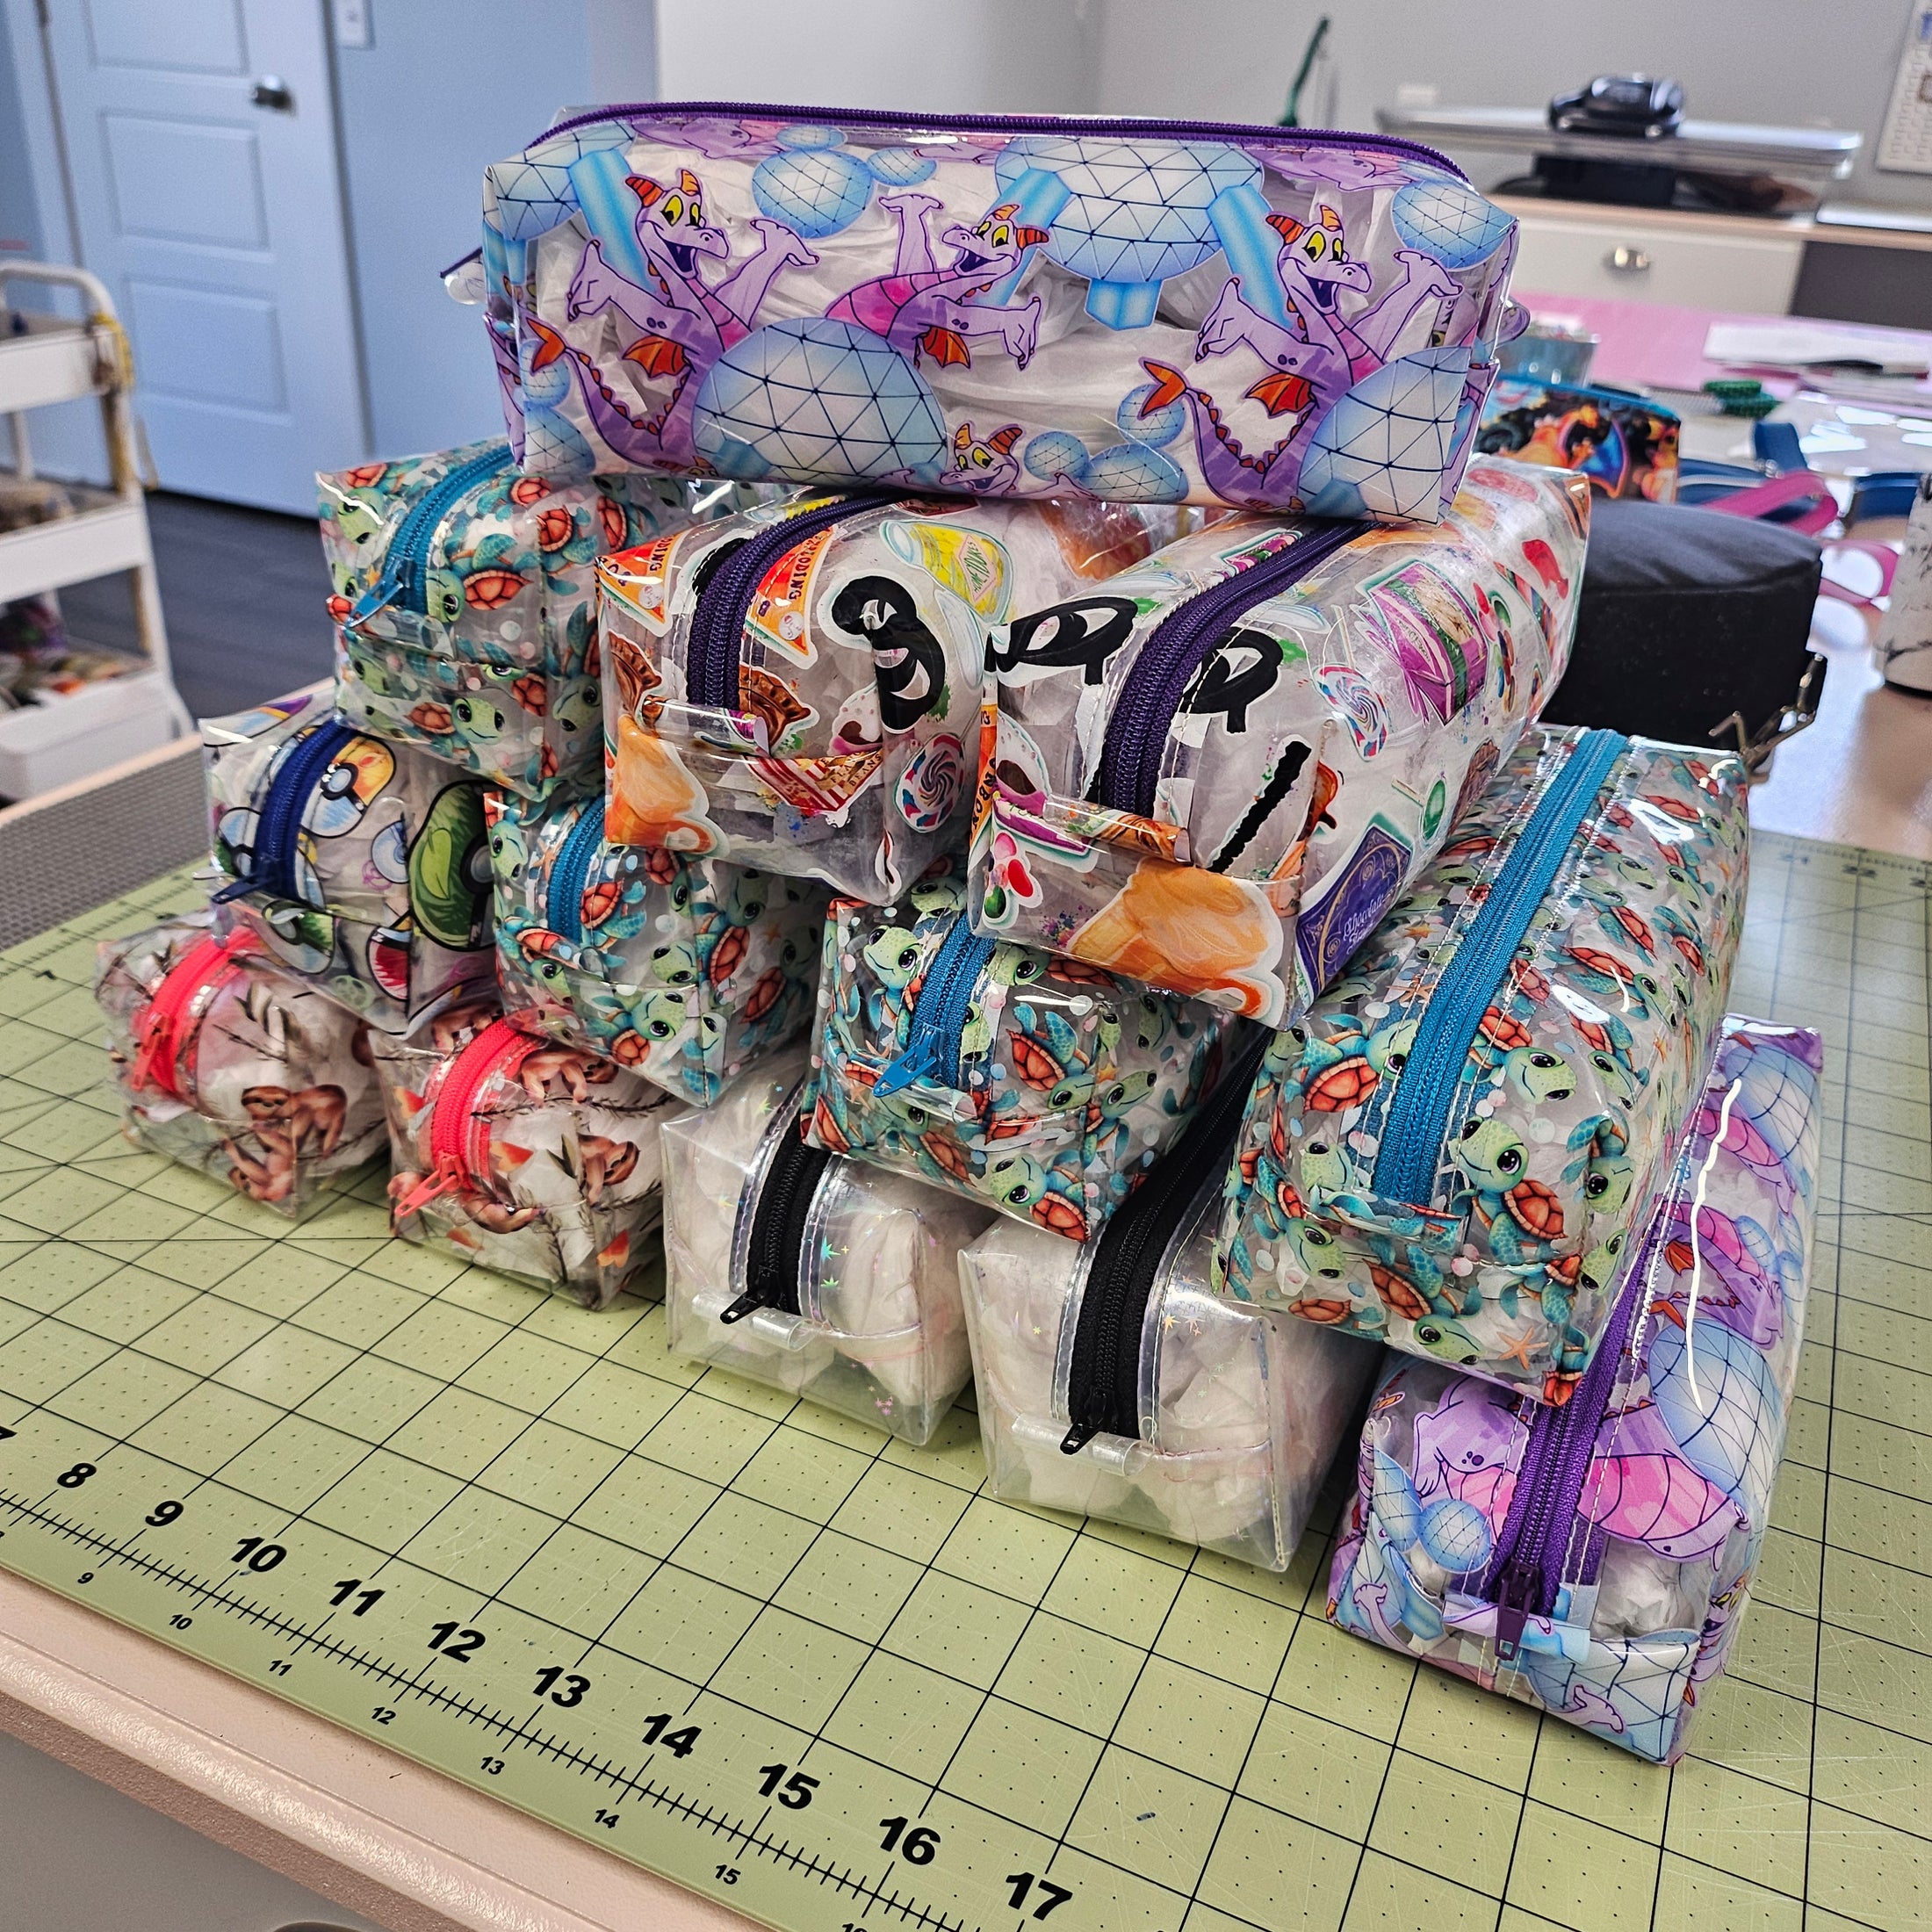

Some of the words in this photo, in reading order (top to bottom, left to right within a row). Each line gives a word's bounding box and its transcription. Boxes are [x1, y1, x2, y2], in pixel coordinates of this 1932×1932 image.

[57, 1463, 97, 1488] 8
[146, 1501, 184, 1526] 9
[231, 1537, 286, 1572] 10
[329, 1580, 385, 1616] 11
[428, 1622, 486, 1662] 12
[533, 1667, 590, 1707] 13
[642, 1714, 702, 1758] 14
[759, 1763, 820, 1809] 15
[880, 1817, 941, 1865] 16
[1006, 1872, 1072, 1921] 17
[77, 1573, 94, 1584] 9
[169, 1614, 192, 1630] 10
[269, 1660, 292, 1676] 11
[371, 1706, 396, 1725] 12
[480, 1756, 506, 1775] 13
[595, 1809, 620, 1829] 14
[715, 1864, 741, 1885] 15
